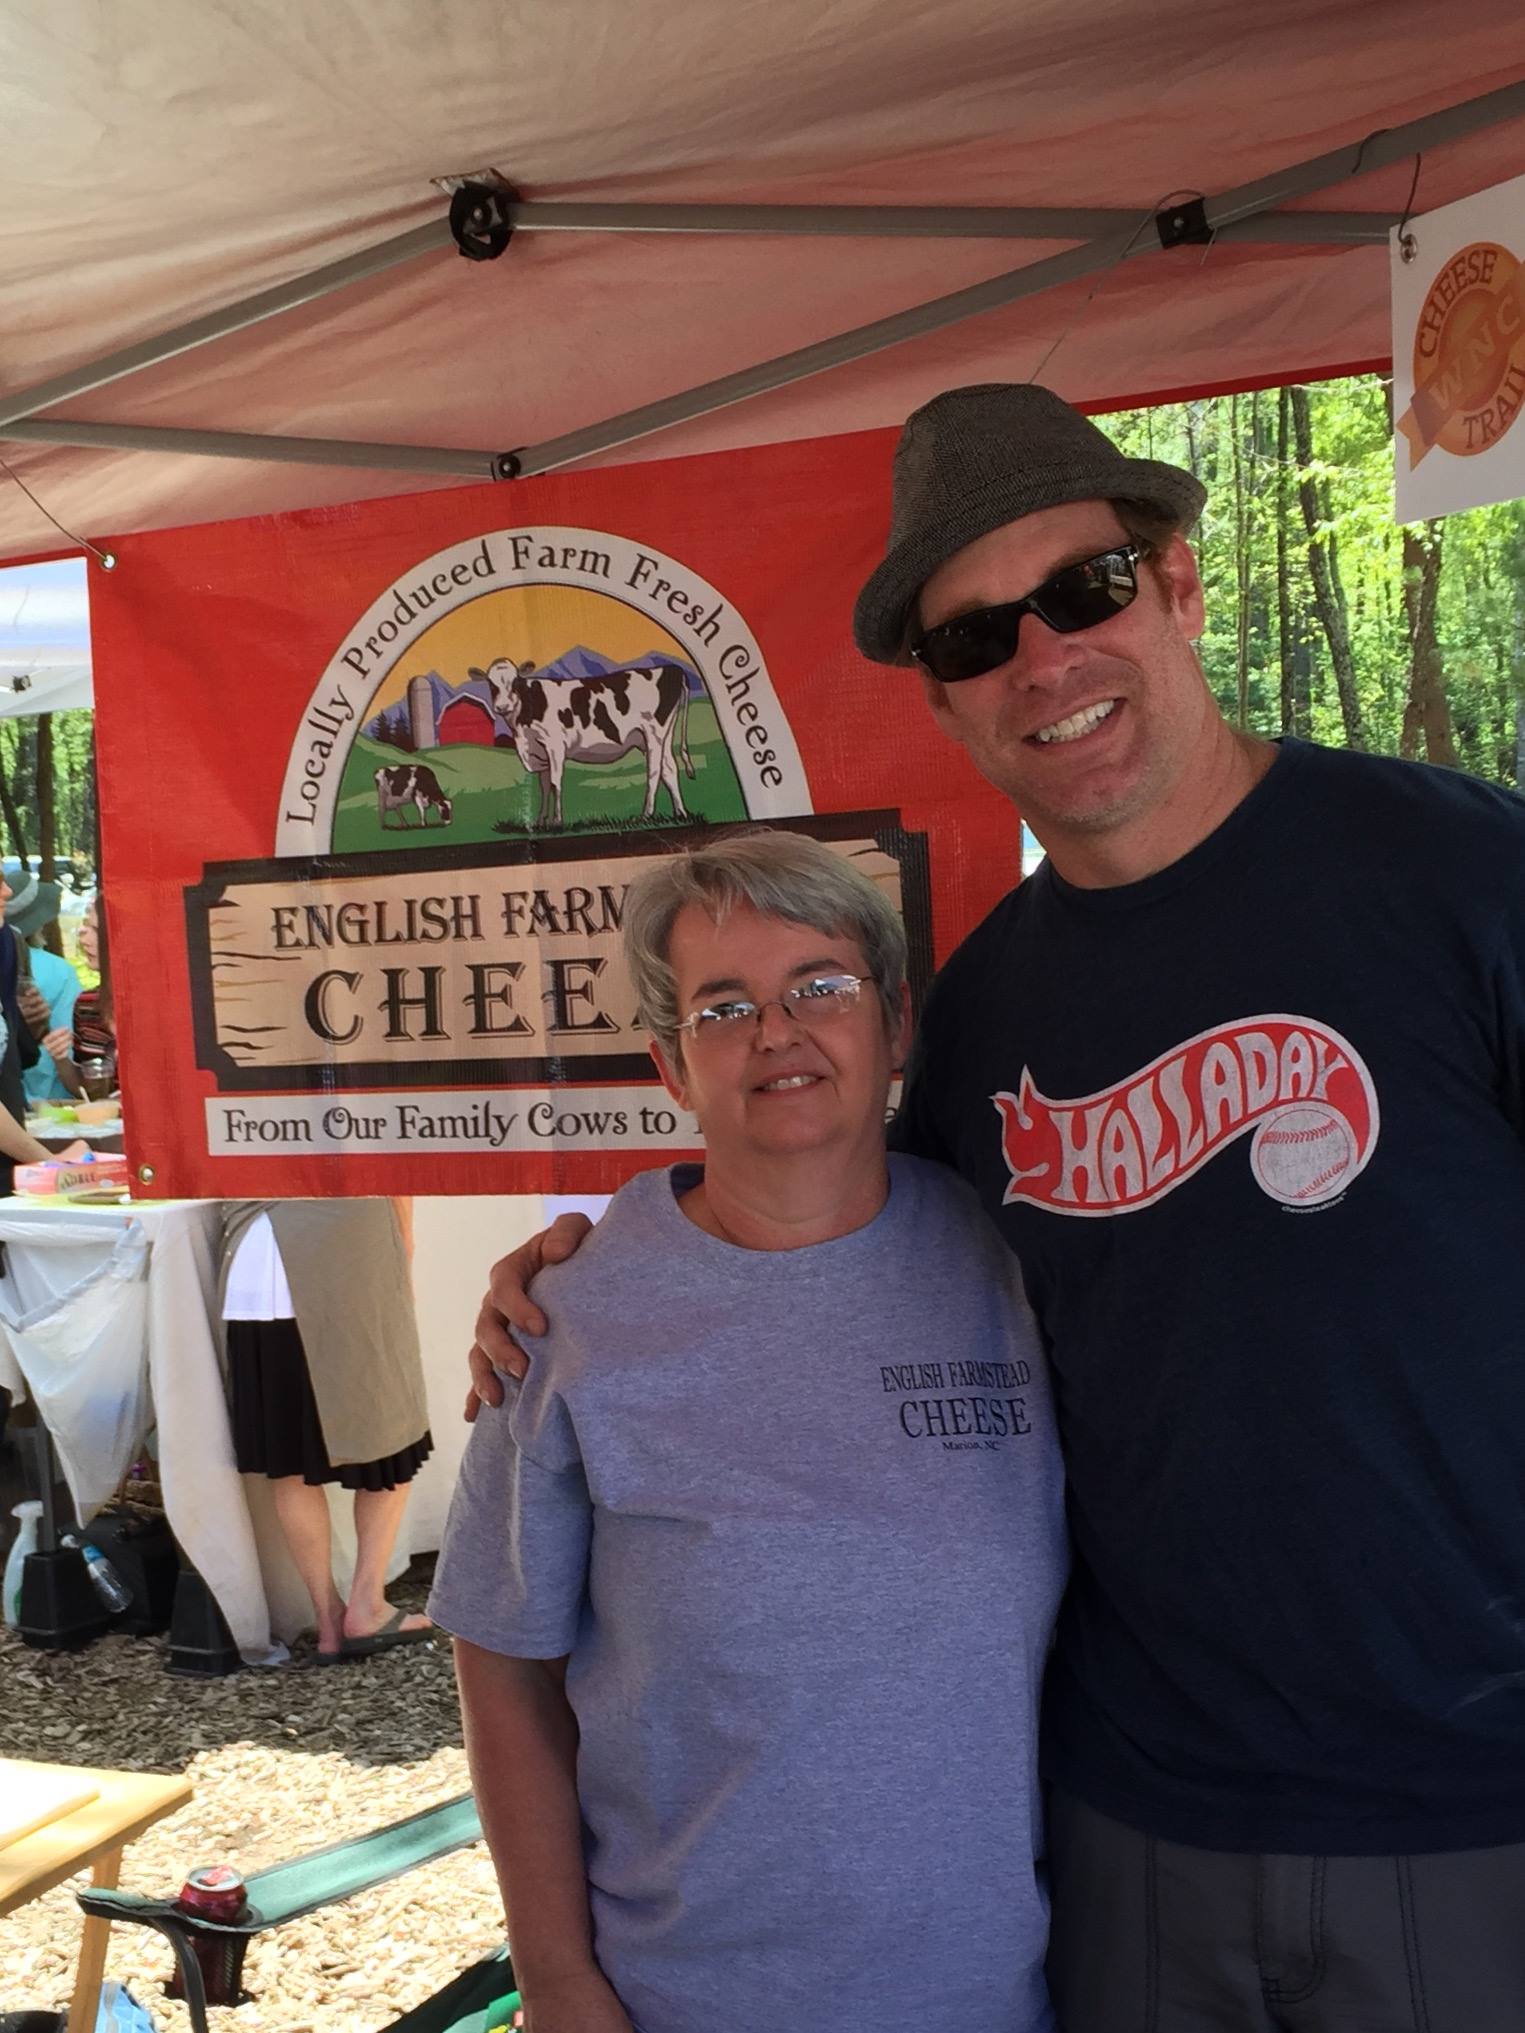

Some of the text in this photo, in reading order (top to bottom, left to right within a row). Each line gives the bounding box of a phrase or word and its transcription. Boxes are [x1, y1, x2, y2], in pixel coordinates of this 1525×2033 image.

[1419, 250, 1498, 358] CHEESE
[286, 536, 783, 826] Locally Produced Farm Fresh Cheese
[271, 884, 631, 951] ENGLISH FARM
[304, 957, 645, 1046] CHEE
[223, 1107, 315, 1144] From
[322, 1106, 388, 1142] Our
[396, 1099, 520, 1148] Family
[528, 1100, 629, 1138] Cows
[639, 1107, 677, 1135] to
[1048, 1030, 1350, 1205] HALLADAY
[879, 1359, 1031, 1393] ENGLISH FARMSTEAD
[900, 1396, 1032, 1439] CHEESE
